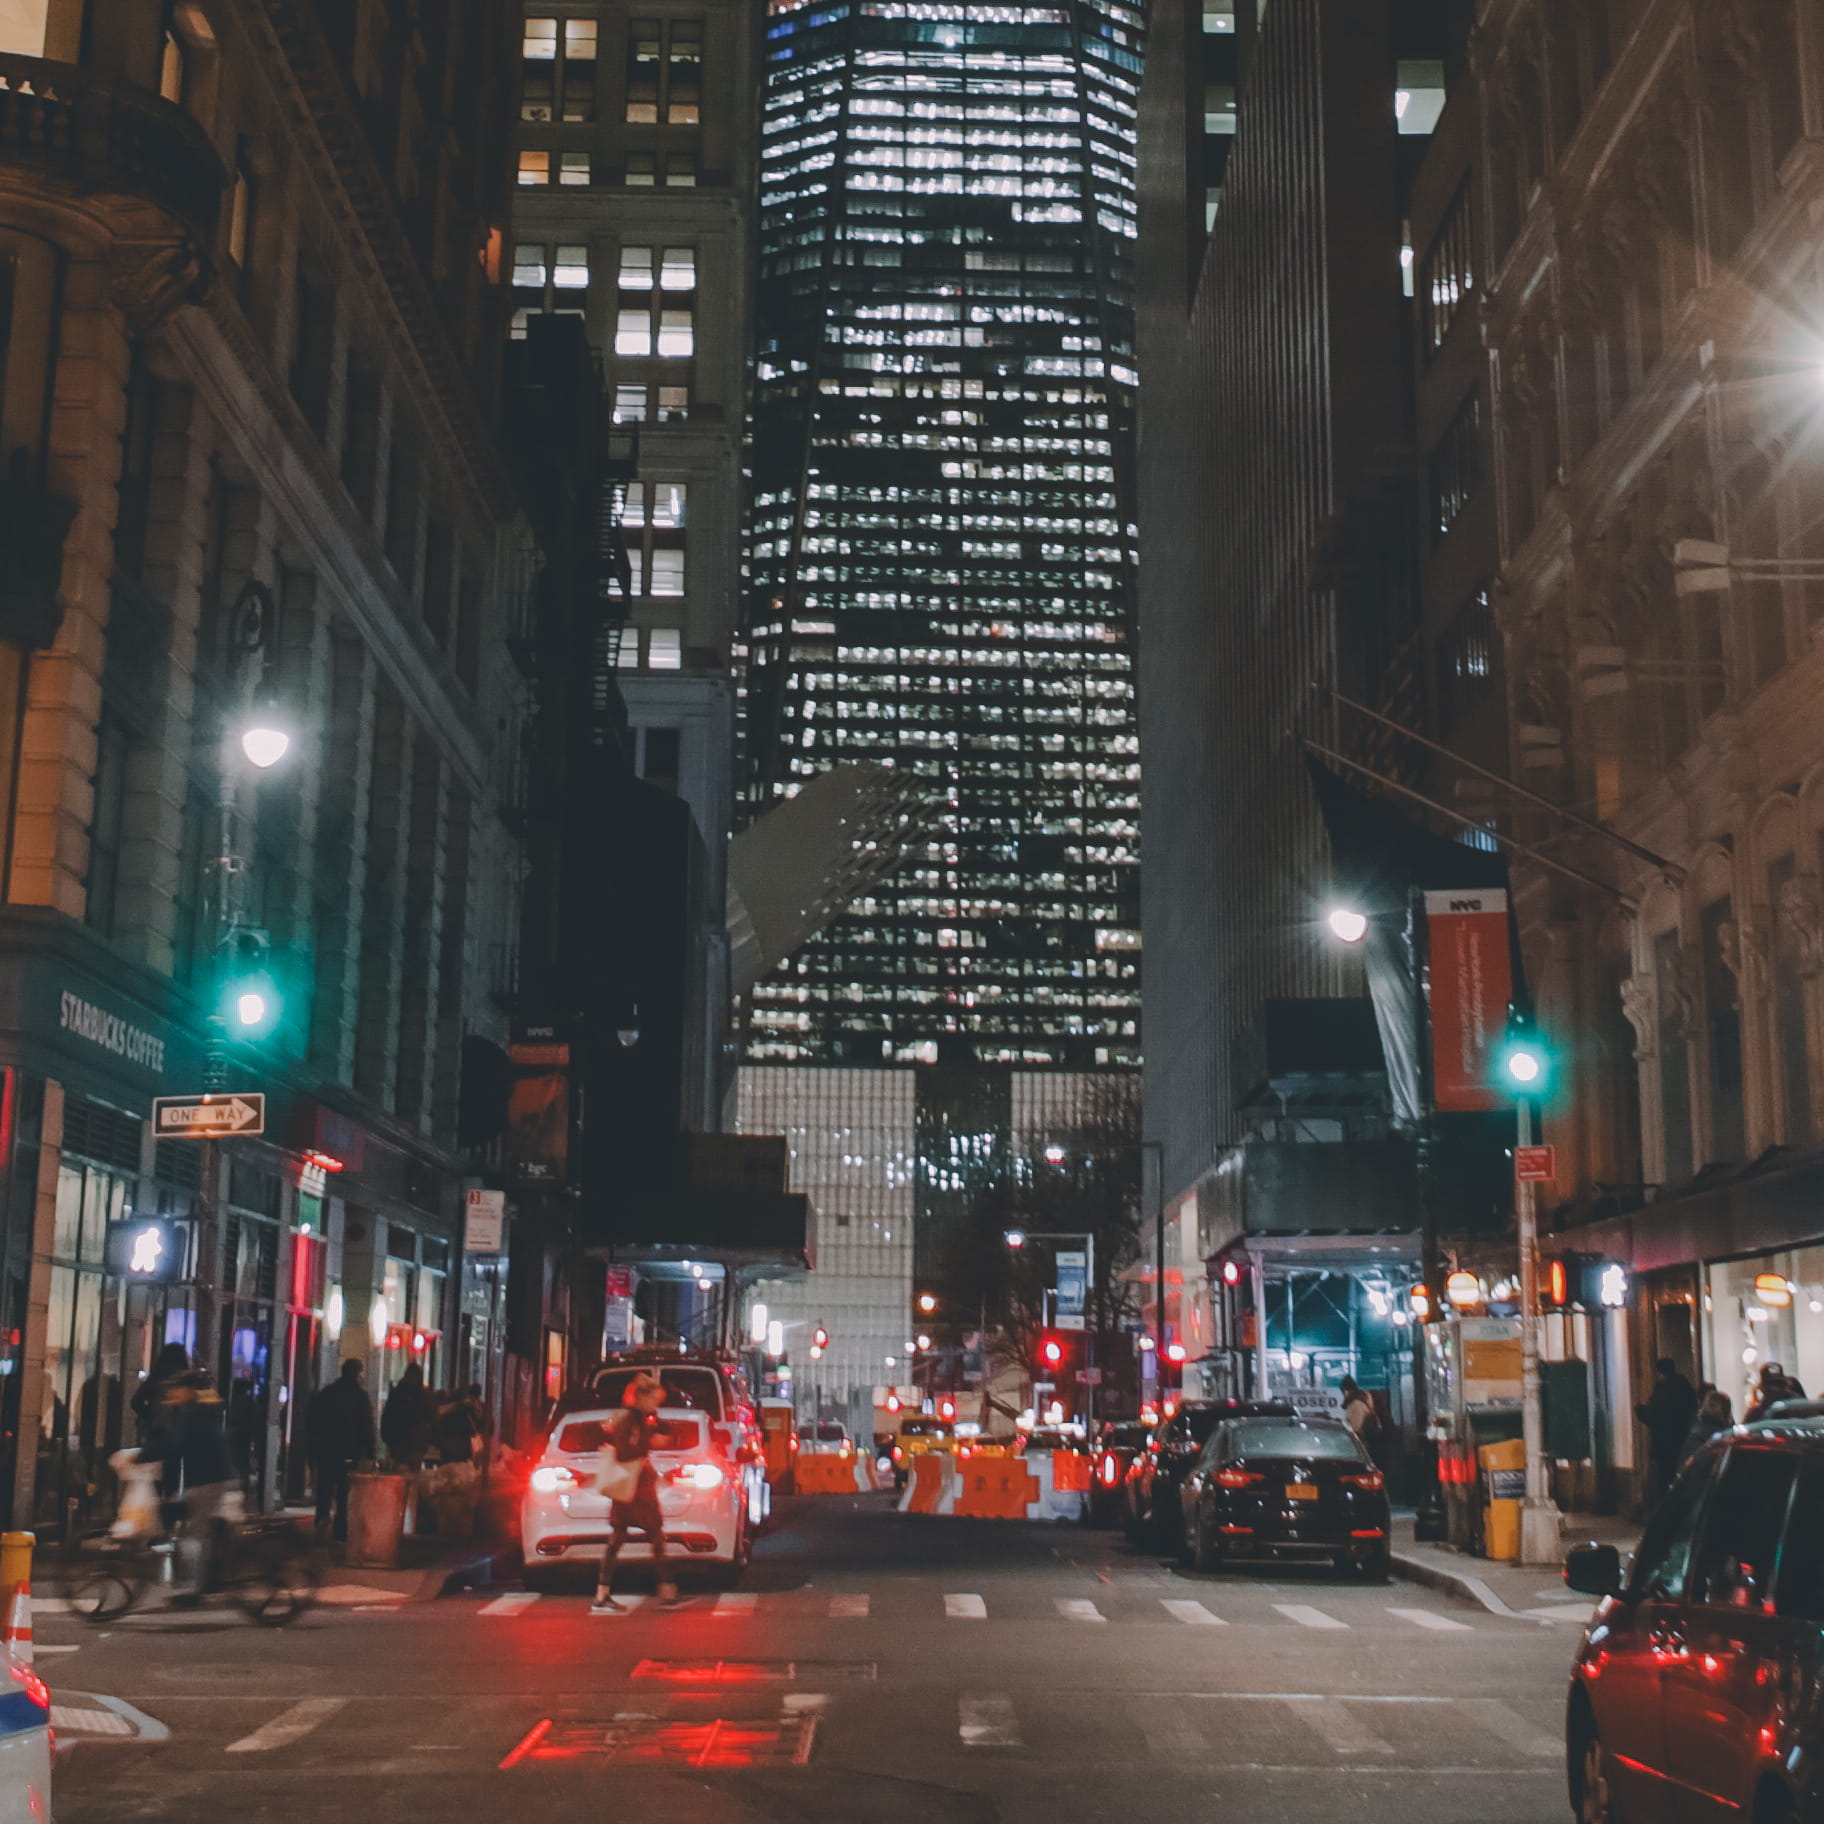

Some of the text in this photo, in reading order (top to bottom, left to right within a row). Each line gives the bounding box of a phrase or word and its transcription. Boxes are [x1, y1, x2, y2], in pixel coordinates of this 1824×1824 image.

[60, 990, 165, 1073] STARBUCKS COFFEE
[170, 1106, 247, 1124] ONE WAY
